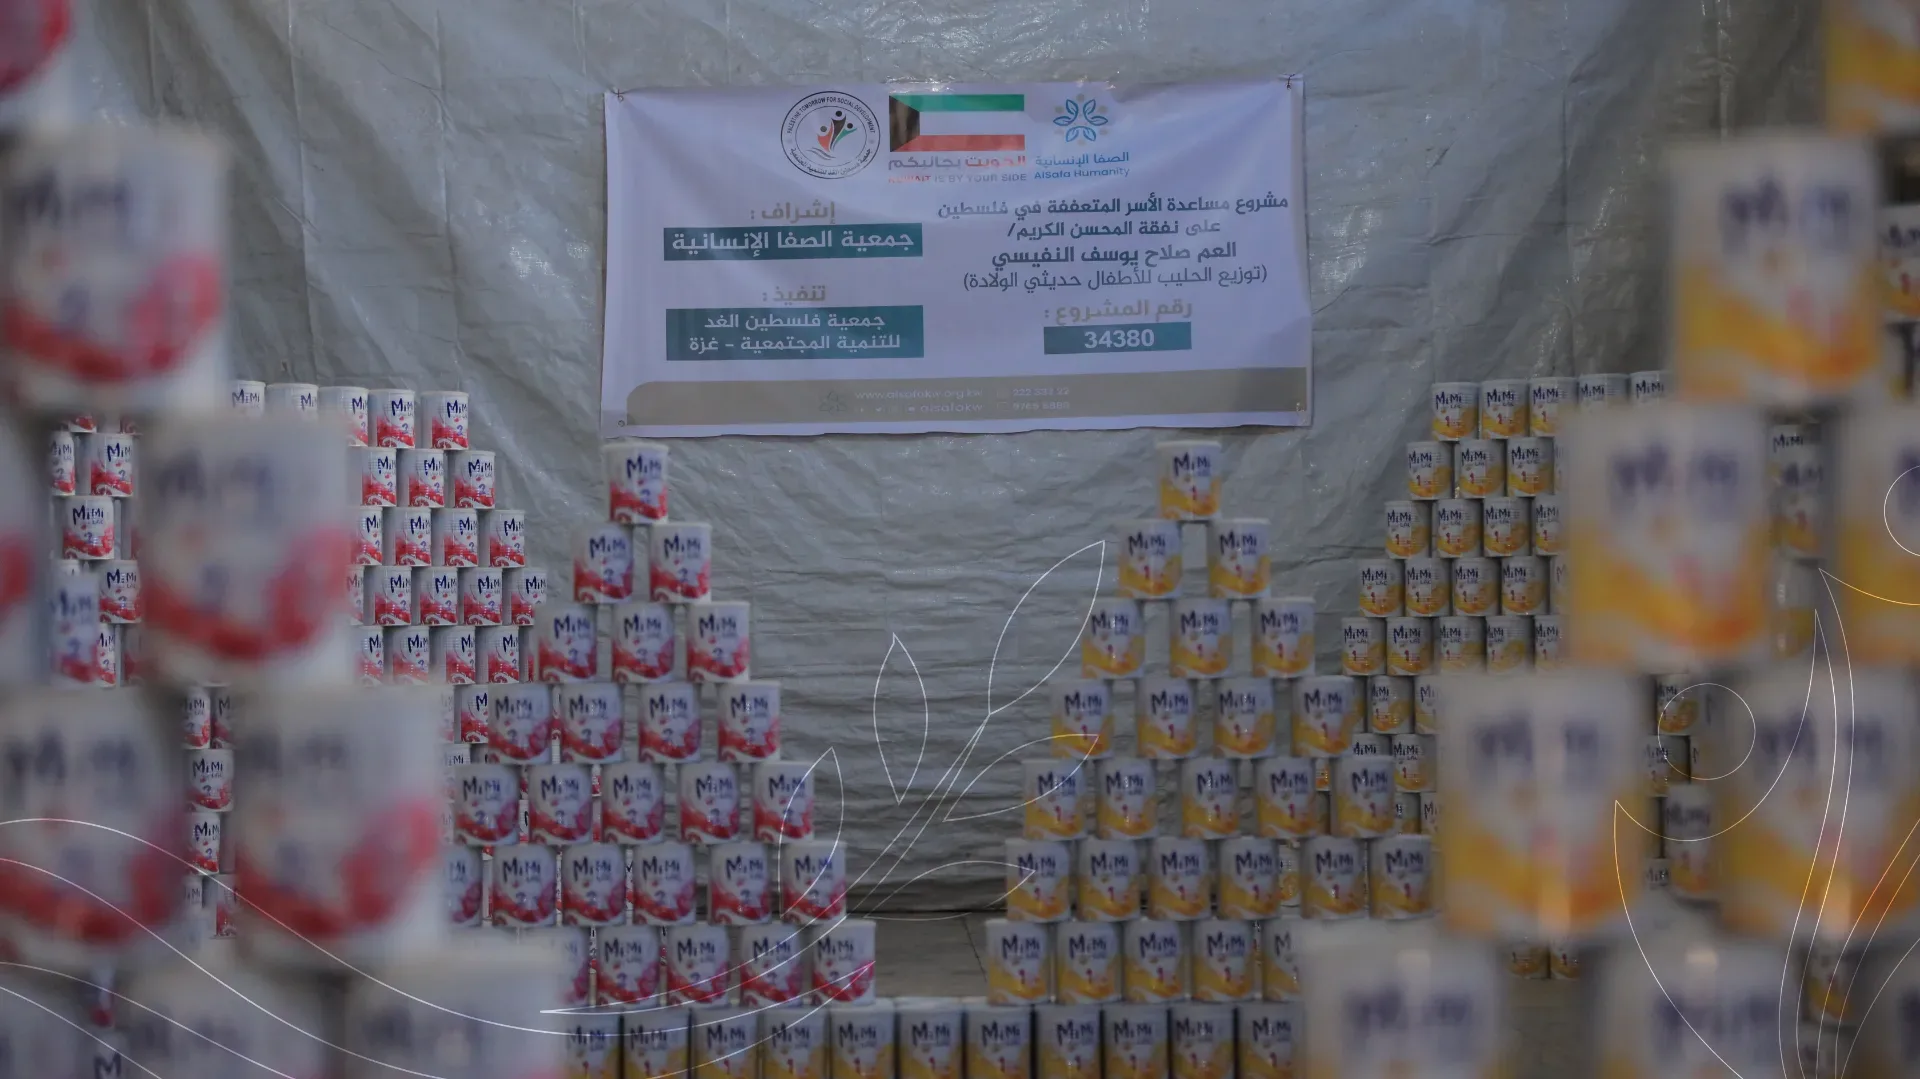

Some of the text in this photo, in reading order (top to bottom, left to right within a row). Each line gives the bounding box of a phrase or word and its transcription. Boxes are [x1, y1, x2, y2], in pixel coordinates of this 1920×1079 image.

[799, 96, 826, 114] TOMORROW
[837, 97, 854, 107] SOCIAL
[854, 104, 876, 134] DEVELOPMENT
[888, 155, 960, 171] بجانبكم
[1036, 151, 1130, 169] الصفا الإنسانية
[949, 174, 964, 183] BY
[967, 173, 998, 183] YOUR
[1001, 172, 1028, 182] SIDE
[1034, 167, 1130, 180] AlSafa Humanity
[761, 199, 836, 225] إشراف
[938, 191, 1289, 220] مشروع مساعدة الأسر المتعففة في فلسطين
[1070, 219, 1132, 239] المحسن
[1138, 220, 1179, 235] نفقة
[1185, 219, 1221, 237] على
[672, 230, 914, 258] جمعية الصفا الإنسانية
[992, 241, 1237, 272] العم صلاح يوسف النفيسي
[963, 264, 1268, 294] (توزيع الحليب للأطفال حديثي الولادة)
[772, 284, 826, 306] تنفيذ
[1056, 298, 1193, 326] رقم المشروع
[704, 313, 885, 332] جمعية فلسطين الغد
[689, 337, 719, 354] غزة
[740, 335, 830, 354] المجتمعية
[837, 334, 901, 353] للتنمية
[1084, 328, 1155, 349] 34380
[1487, 388, 1514, 407] MiMi
[1532, 386, 1559, 405] MiMi
[1636, 379, 1664, 398] MiMi
[1436, 391, 1462, 410] MiMi
[1409, 448, 1432, 467] MiMi
[1461, 448, 1486, 466] MiMi
[1511, 445, 1539, 465] MiMi
[73, 505, 104, 525] MiMi
[1387, 509, 1411, 527] MiMi
[1438, 507, 1462, 526] MiMi
[1485, 505, 1511, 525] MiMi
[107, 568, 137, 589] MiMi
[1362, 566, 1387, 585] MiMi
[1407, 566, 1432, 585] MiMi
[1455, 565, 1479, 584] MiMi
[1503, 564, 1527, 584] MiMi
[1344, 625, 1368, 645] MiMi
[1393, 624, 1421, 644] MiMi
[193, 758, 223, 778] MiMi
